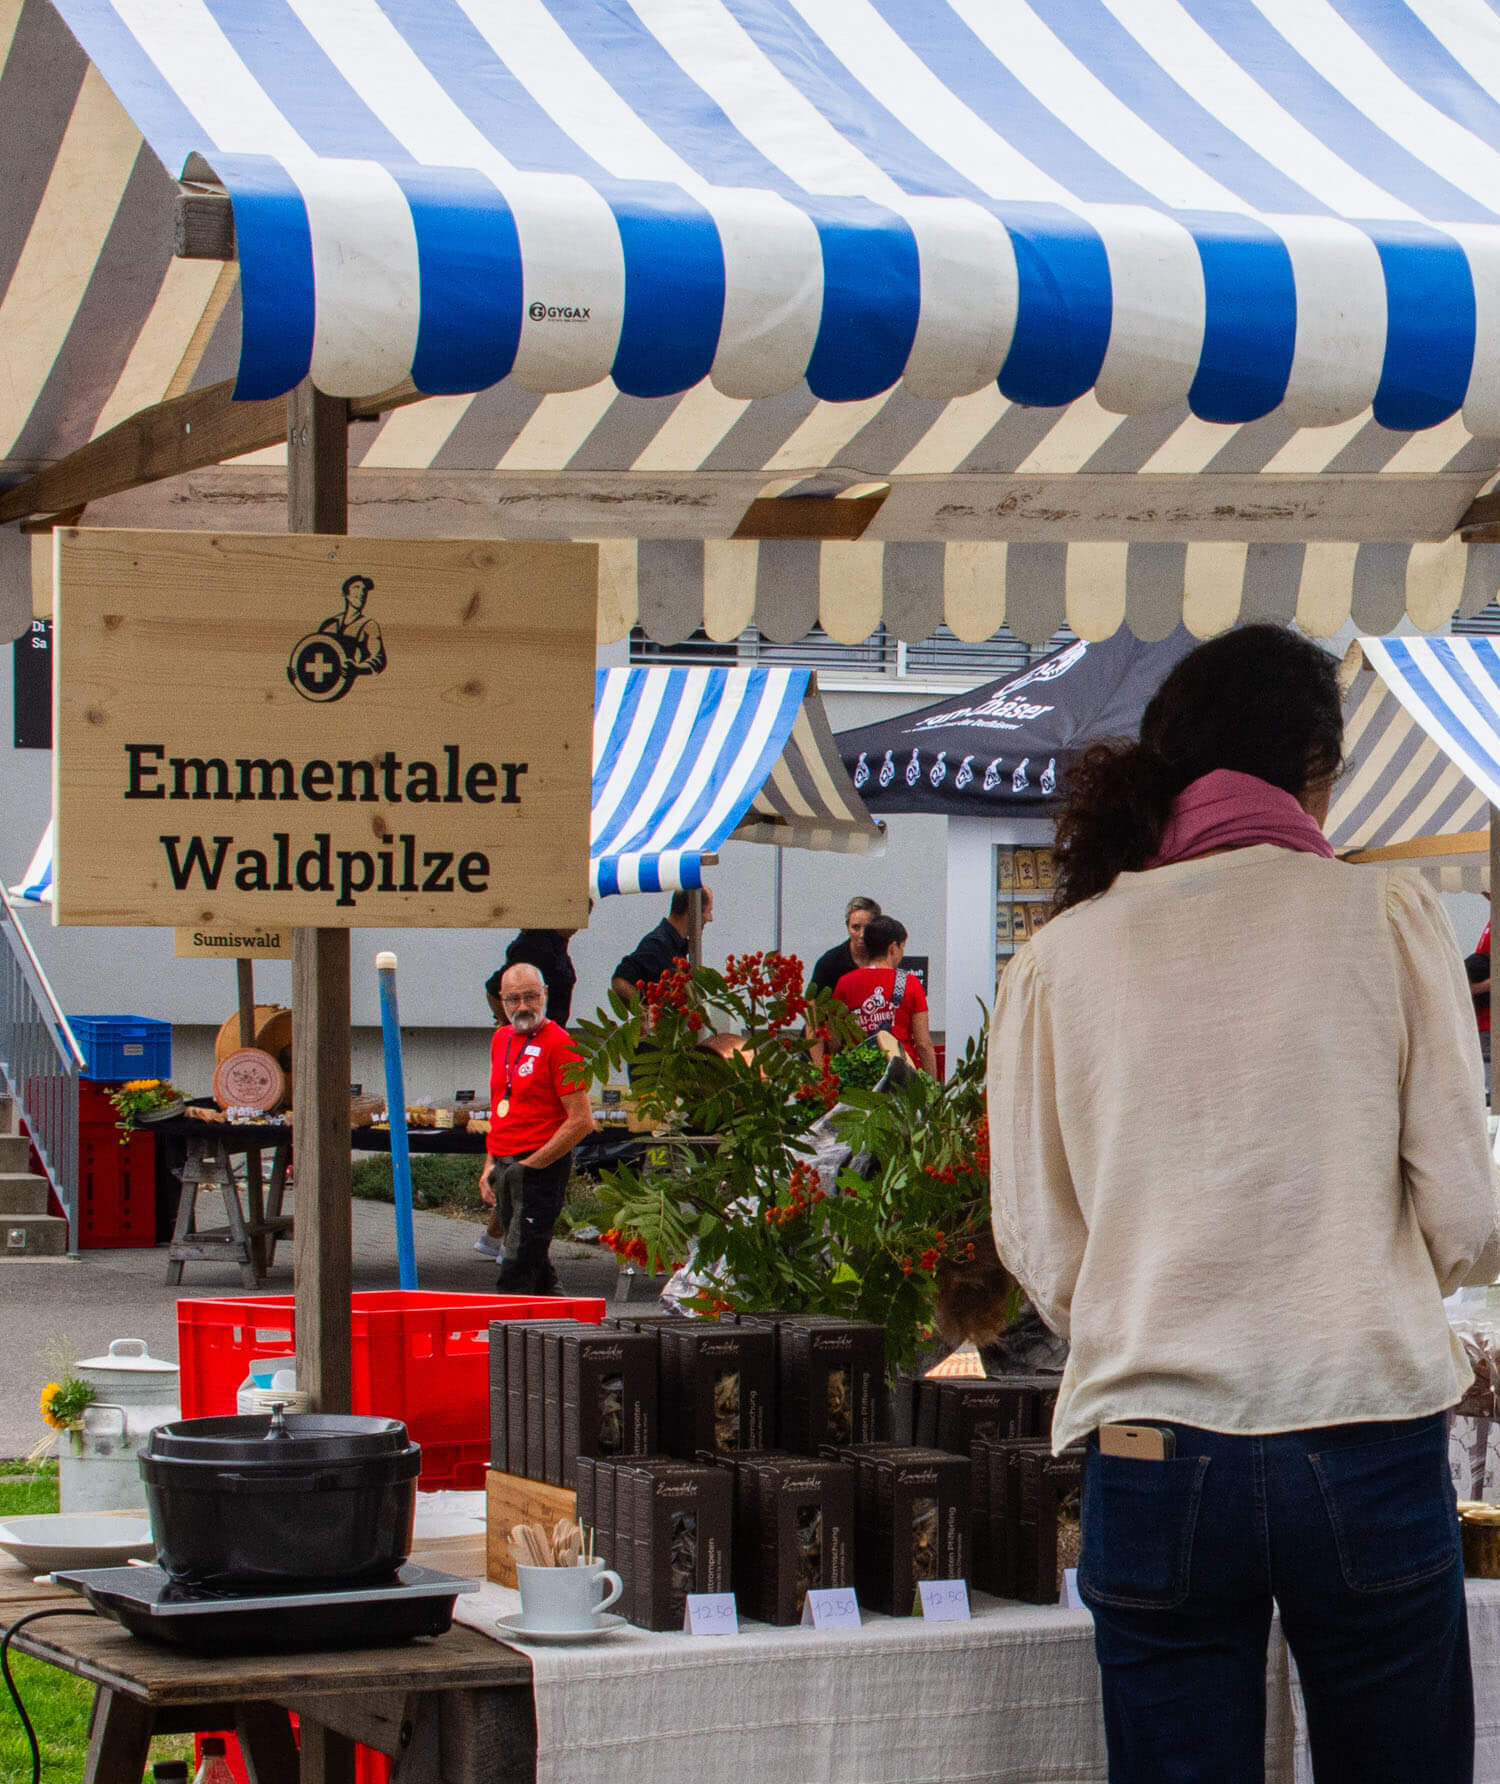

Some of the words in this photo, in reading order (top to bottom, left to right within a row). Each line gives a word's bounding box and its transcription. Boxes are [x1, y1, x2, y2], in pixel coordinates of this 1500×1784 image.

[548, 307, 591, 318] GYGAX
[32, 620, 46, 632] Di
[32, 637, 48, 648] Sa
[124, 744, 529, 803] Emmentaler
[159, 833, 491, 906] Waldpilze
[193, 932, 281, 948] Sumiswald
